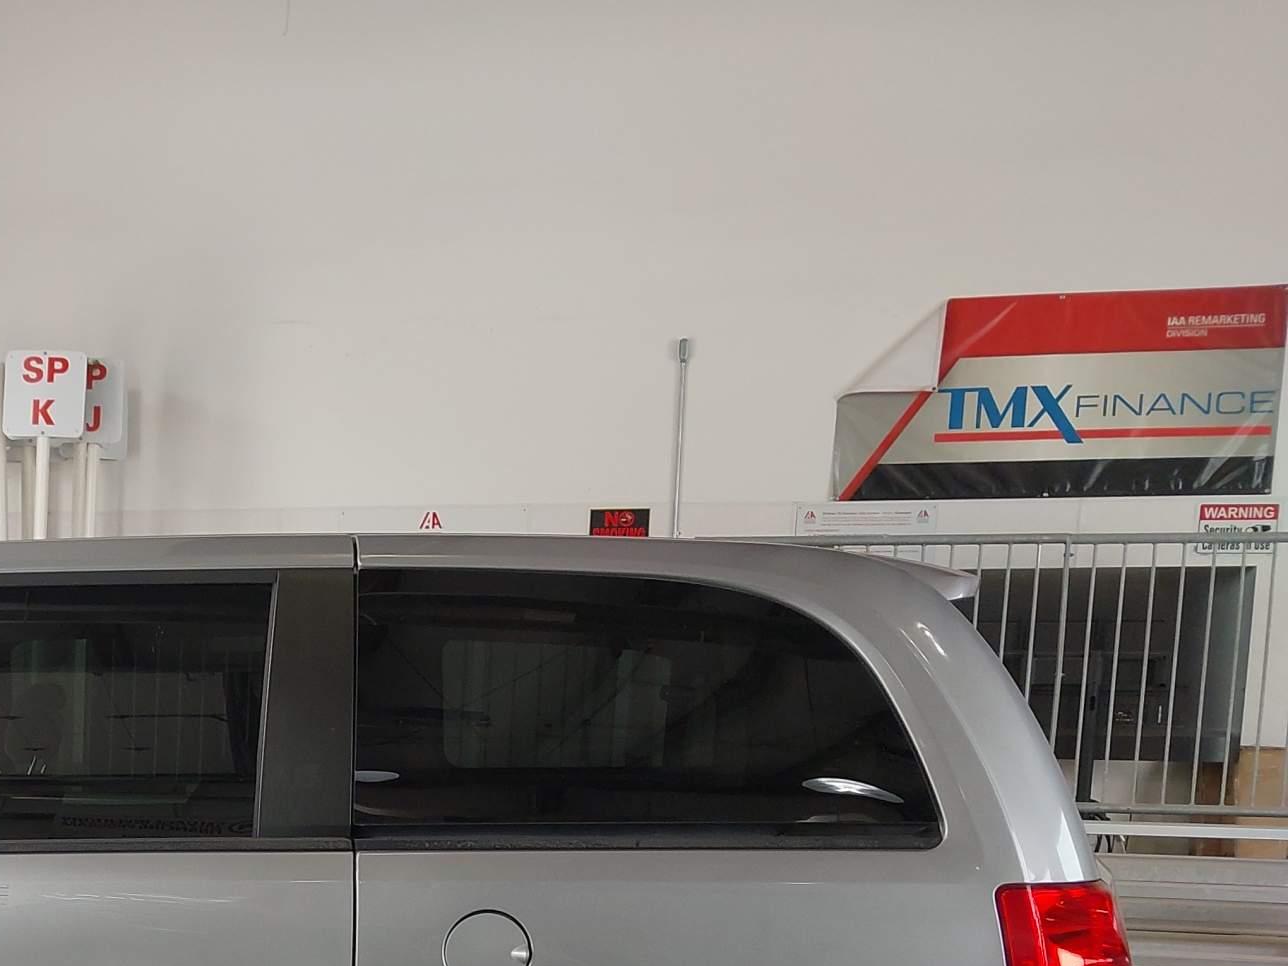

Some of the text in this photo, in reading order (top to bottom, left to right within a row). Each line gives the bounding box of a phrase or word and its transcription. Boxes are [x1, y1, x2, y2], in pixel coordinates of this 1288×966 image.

[1167, 313, 1266, 326] IAA REMARKETING
[1166, 328, 1208, 338] DIVISION
[22, 356, 69, 383] SP
[32, 399, 55, 425] K
[937, 384, 1276, 444] TMX FINANCE
[1204, 506, 1276, 519] WARNING
